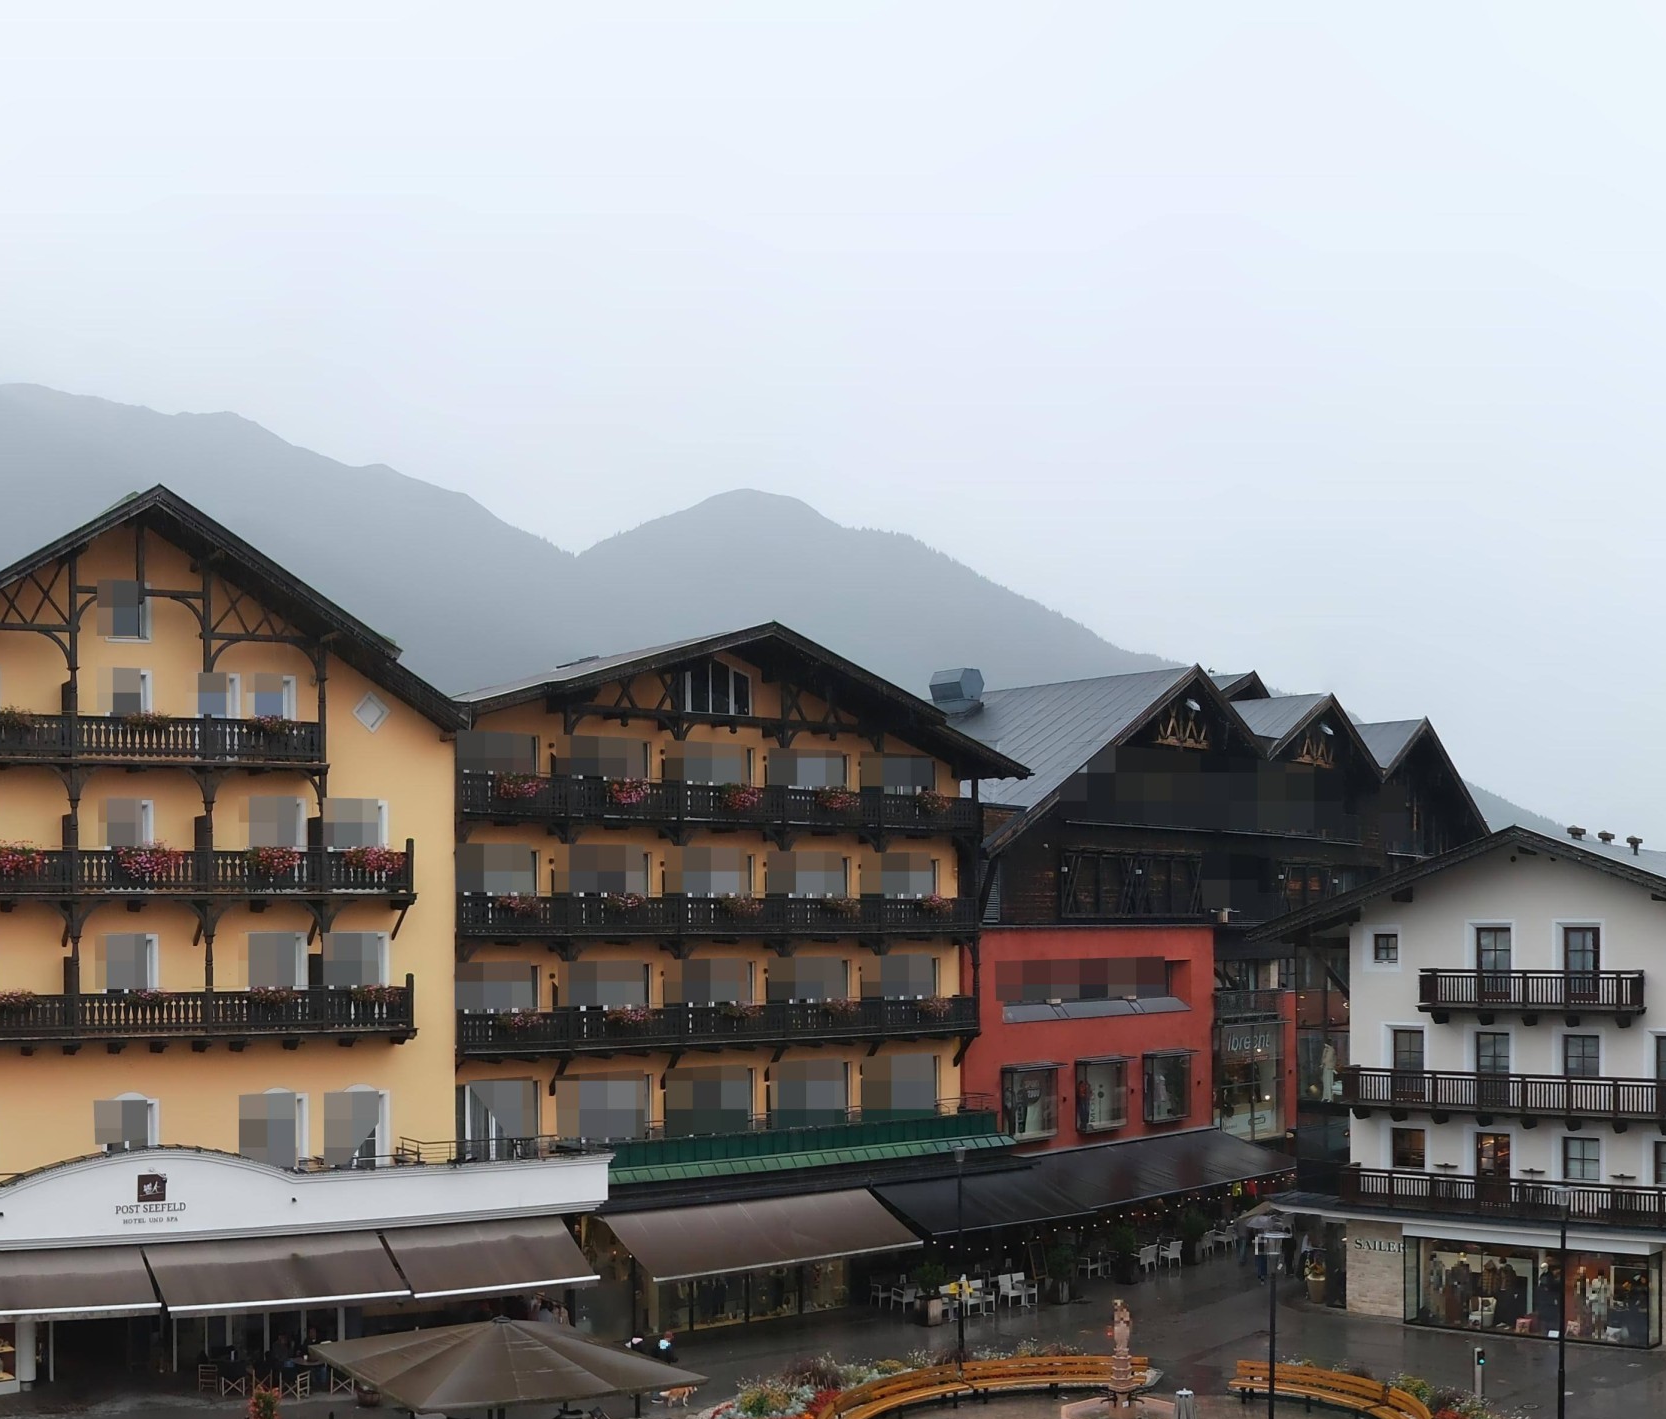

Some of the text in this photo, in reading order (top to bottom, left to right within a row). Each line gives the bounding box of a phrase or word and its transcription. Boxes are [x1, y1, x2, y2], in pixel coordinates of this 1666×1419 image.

[115, 1202, 186, 1214] POST SEEFELD
[1354, 1239, 1406, 1253] SAILER
